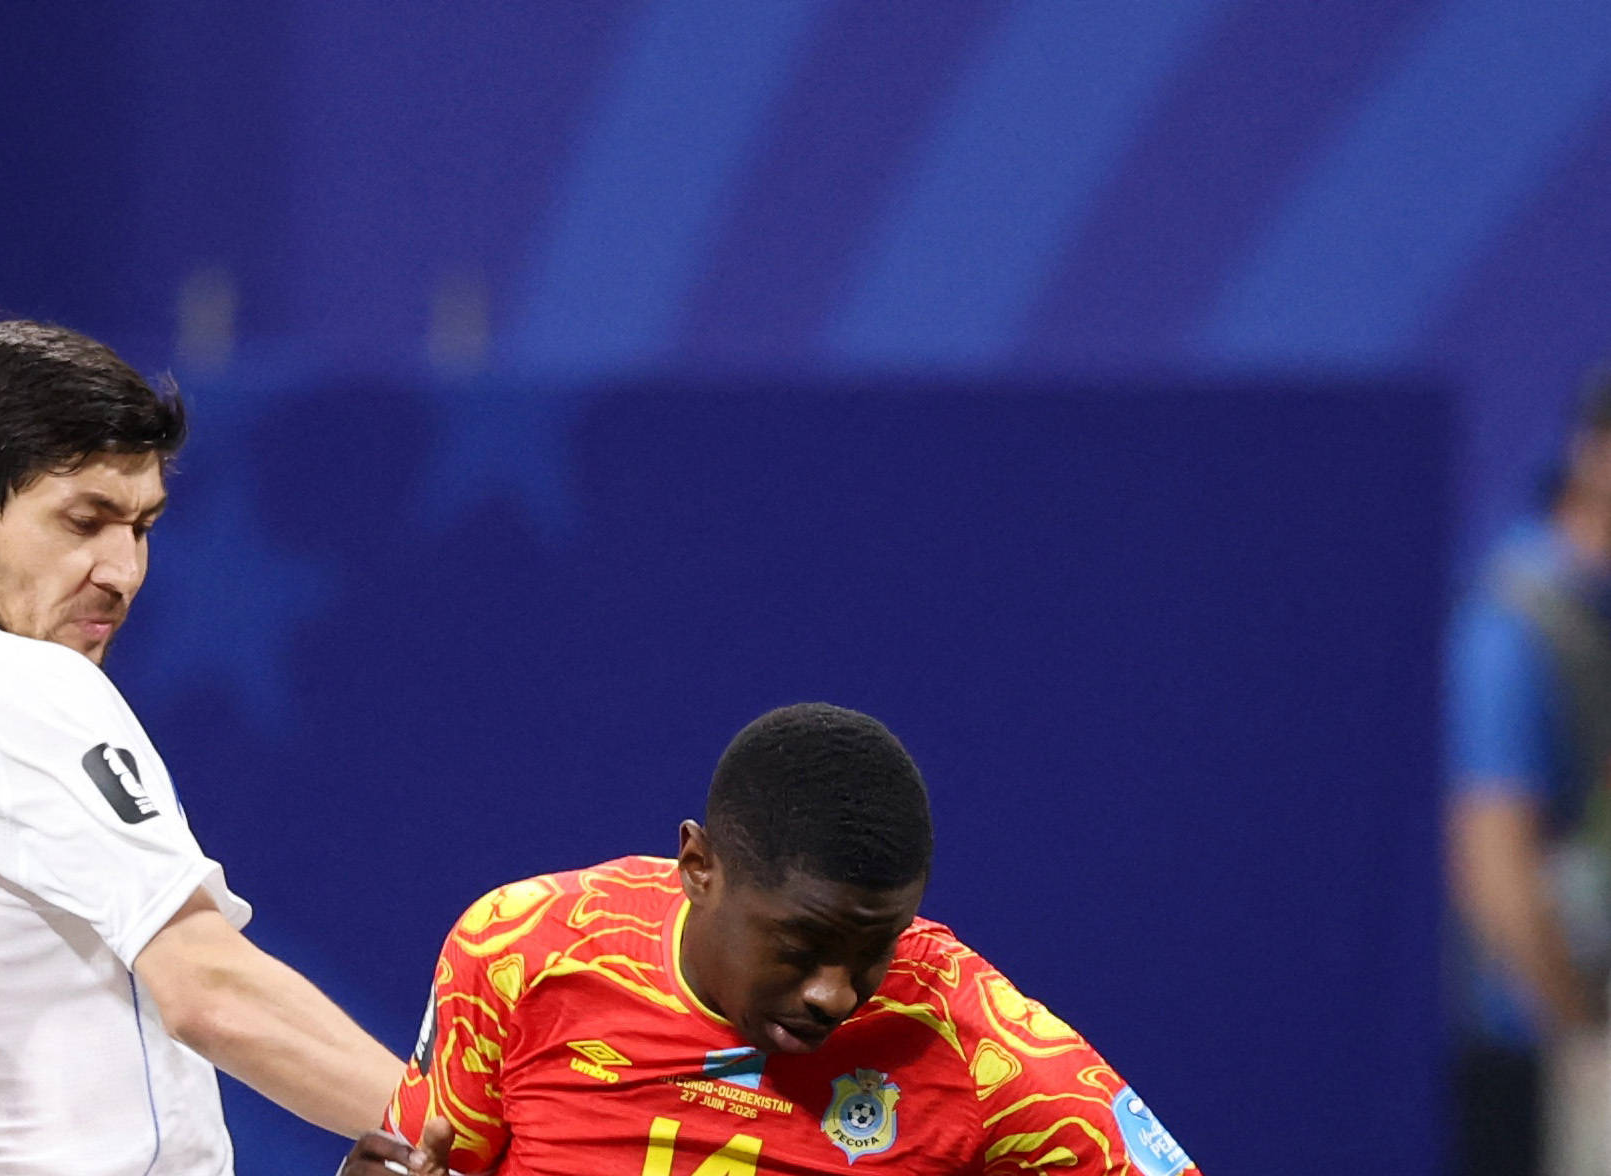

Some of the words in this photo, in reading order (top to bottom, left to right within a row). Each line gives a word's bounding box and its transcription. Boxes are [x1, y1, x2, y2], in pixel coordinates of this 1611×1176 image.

[570, 1057, 619, 1083] umbro
[680, 1090, 697, 1103] 27
[699, 1096, 726, 1111] JUIN
[731, 1102, 759, 1119] 2026
[833, 1129, 880, 1148] FECOFA
